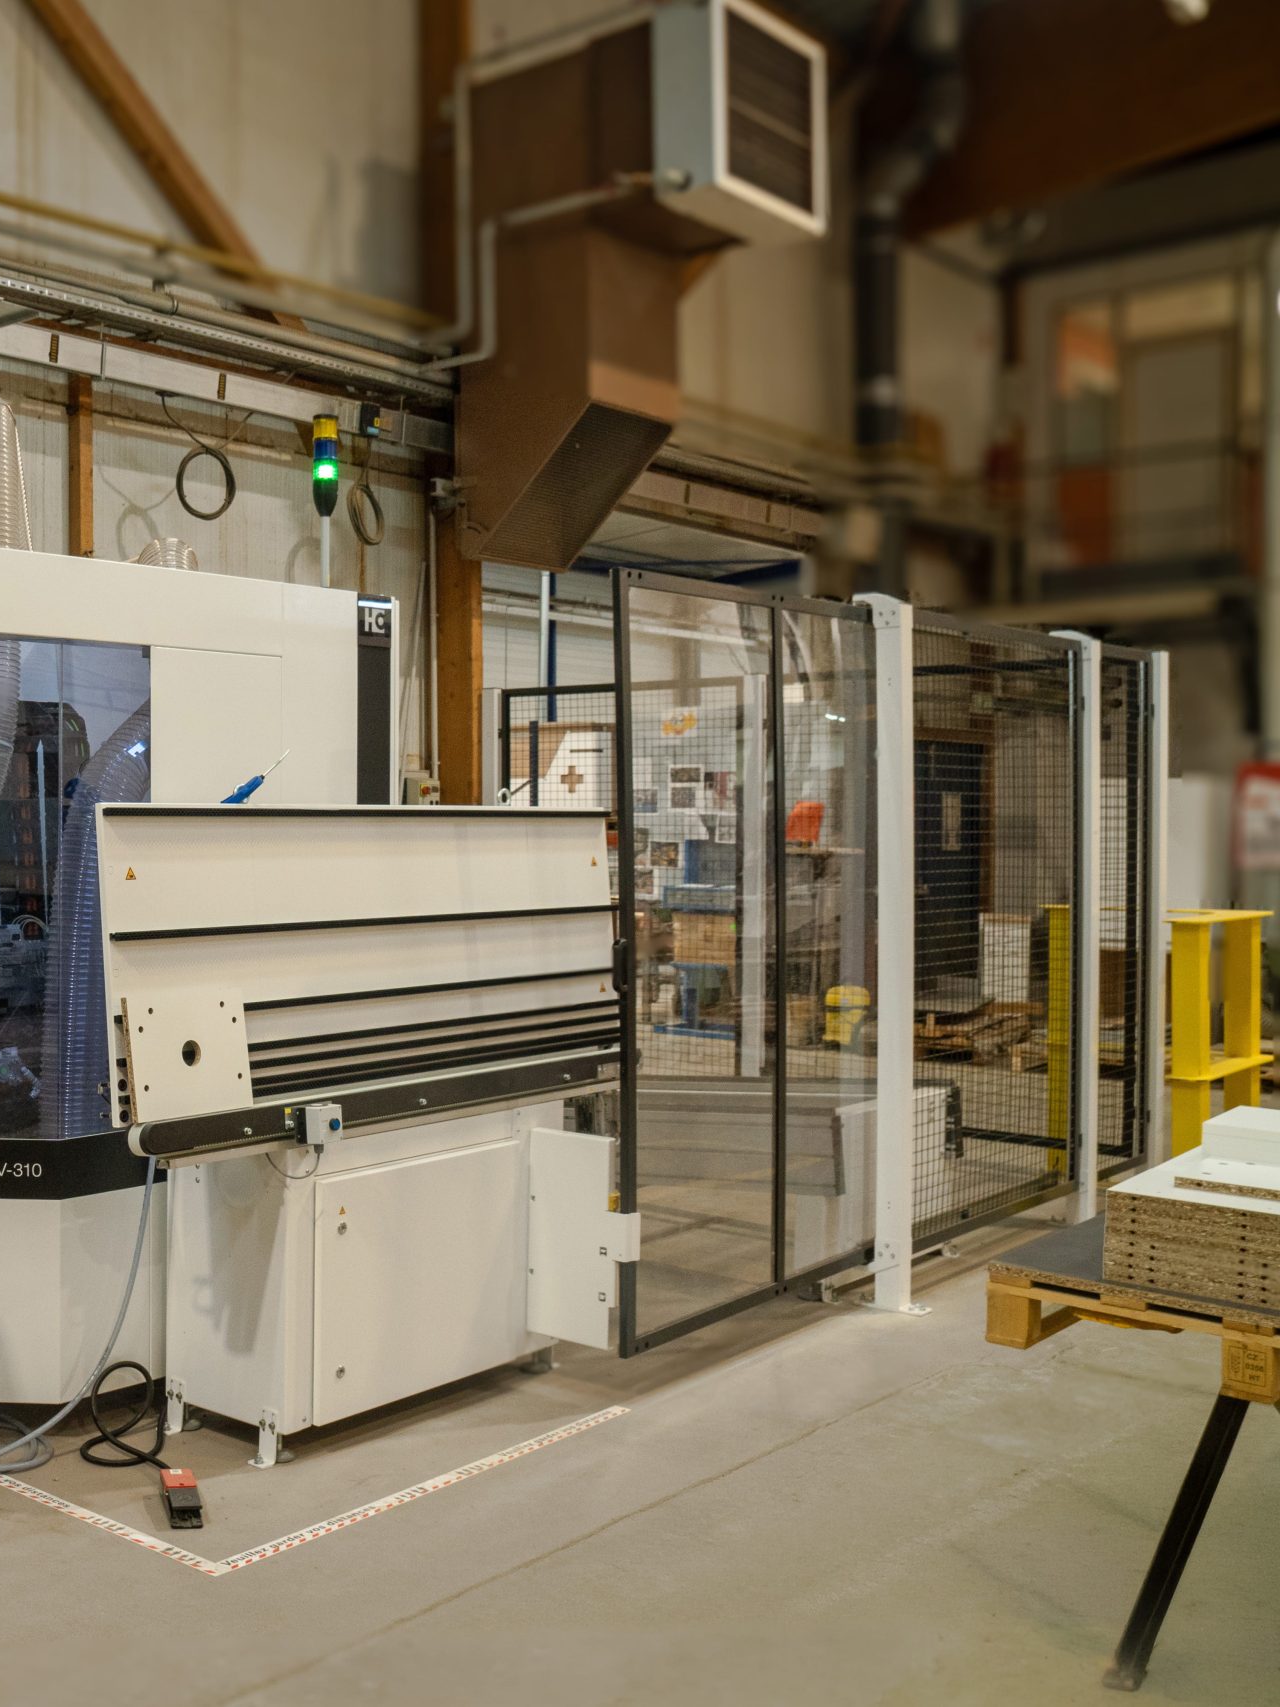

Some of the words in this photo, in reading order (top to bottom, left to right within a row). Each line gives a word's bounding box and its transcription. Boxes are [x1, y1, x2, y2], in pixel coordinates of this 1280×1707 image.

[22, 1486, 70, 1508] distances
[220, 1547, 269, 1567] Veuillez
[269, 1532, 305, 1550] garder
[306, 1525, 326, 1535] vos
[326, 1505, 377, 1527] distances
